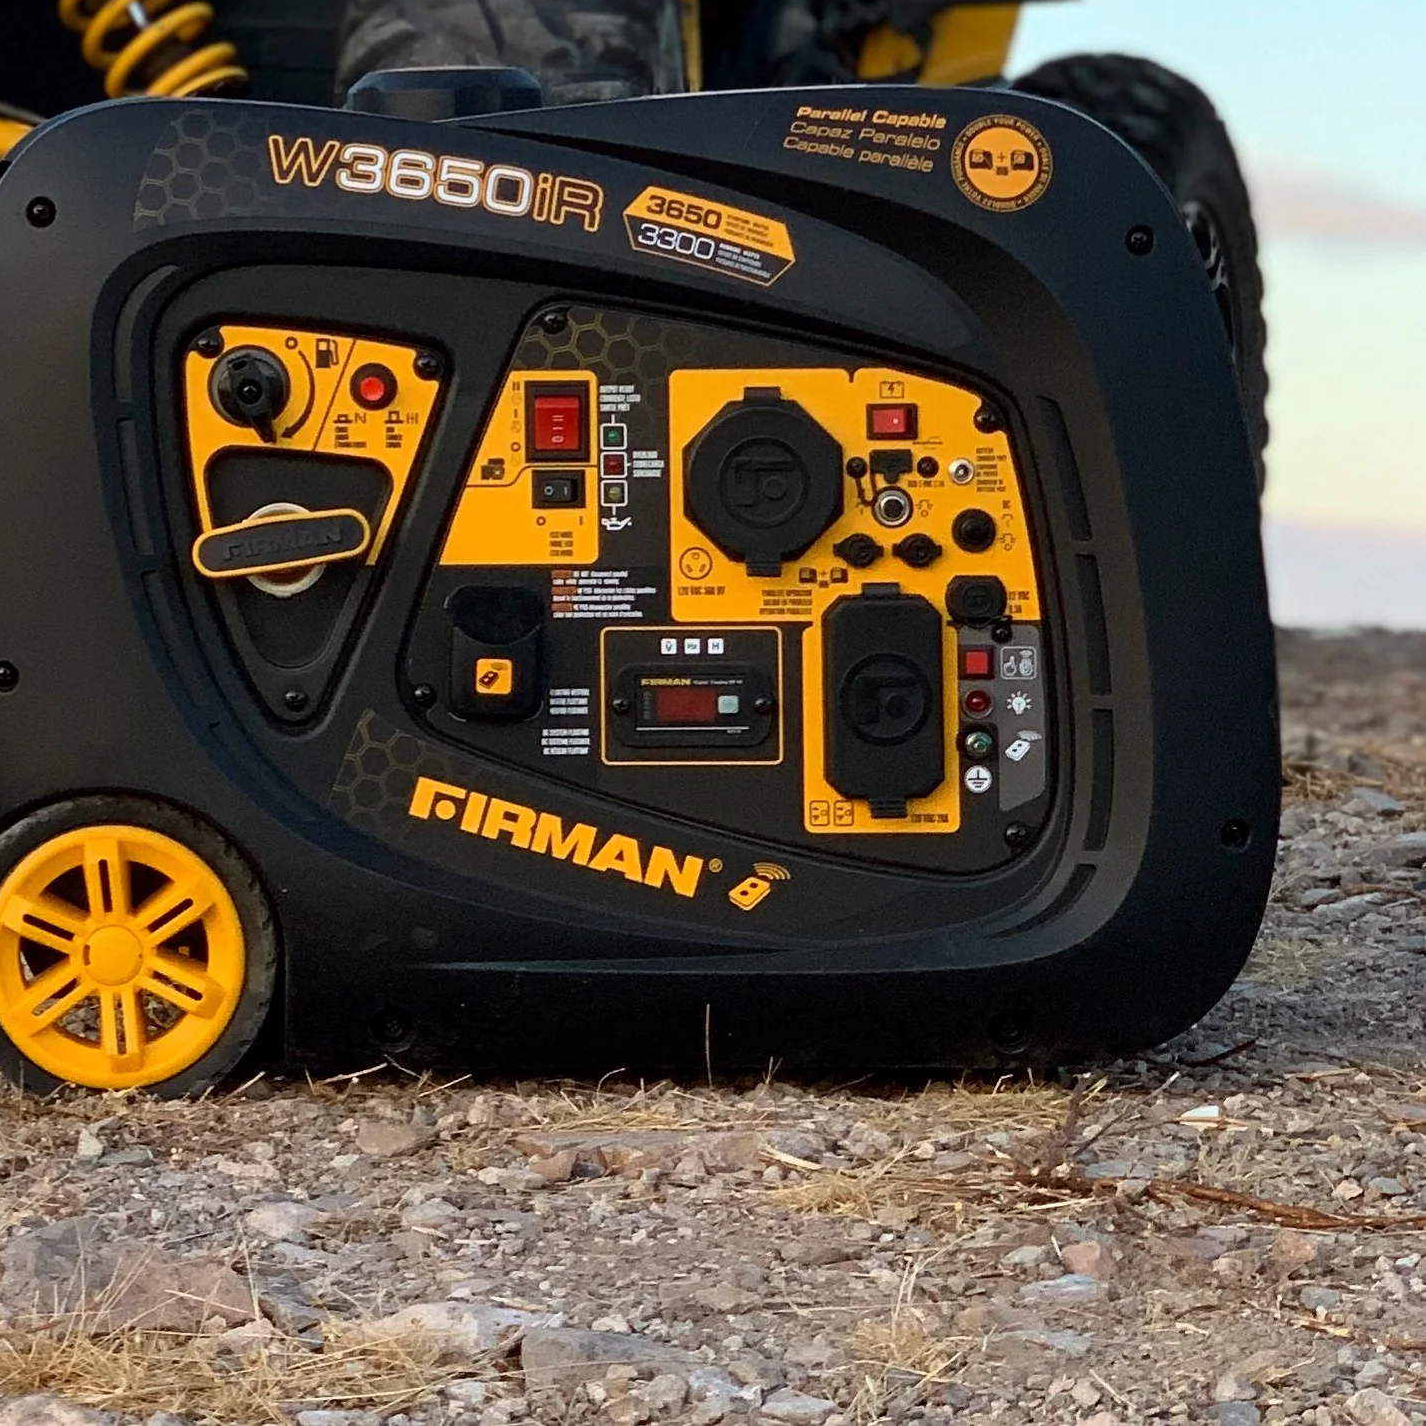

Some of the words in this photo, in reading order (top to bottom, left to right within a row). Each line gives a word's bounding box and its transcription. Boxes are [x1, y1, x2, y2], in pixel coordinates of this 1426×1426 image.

[796, 106, 868, 122] Parallel
[872, 110, 947, 129] Capable
[783, 136, 855, 158] Capable
[790, 121, 853, 140] Capaz
[858, 127, 941, 151] Paralelo
[268, 134, 604, 233] W3650iR
[646, 194, 722, 230] 3650
[637, 223, 715, 260] 3300
[640, 678, 692, 687] FIRMAN
[408, 776, 704, 889] FIRMAN
